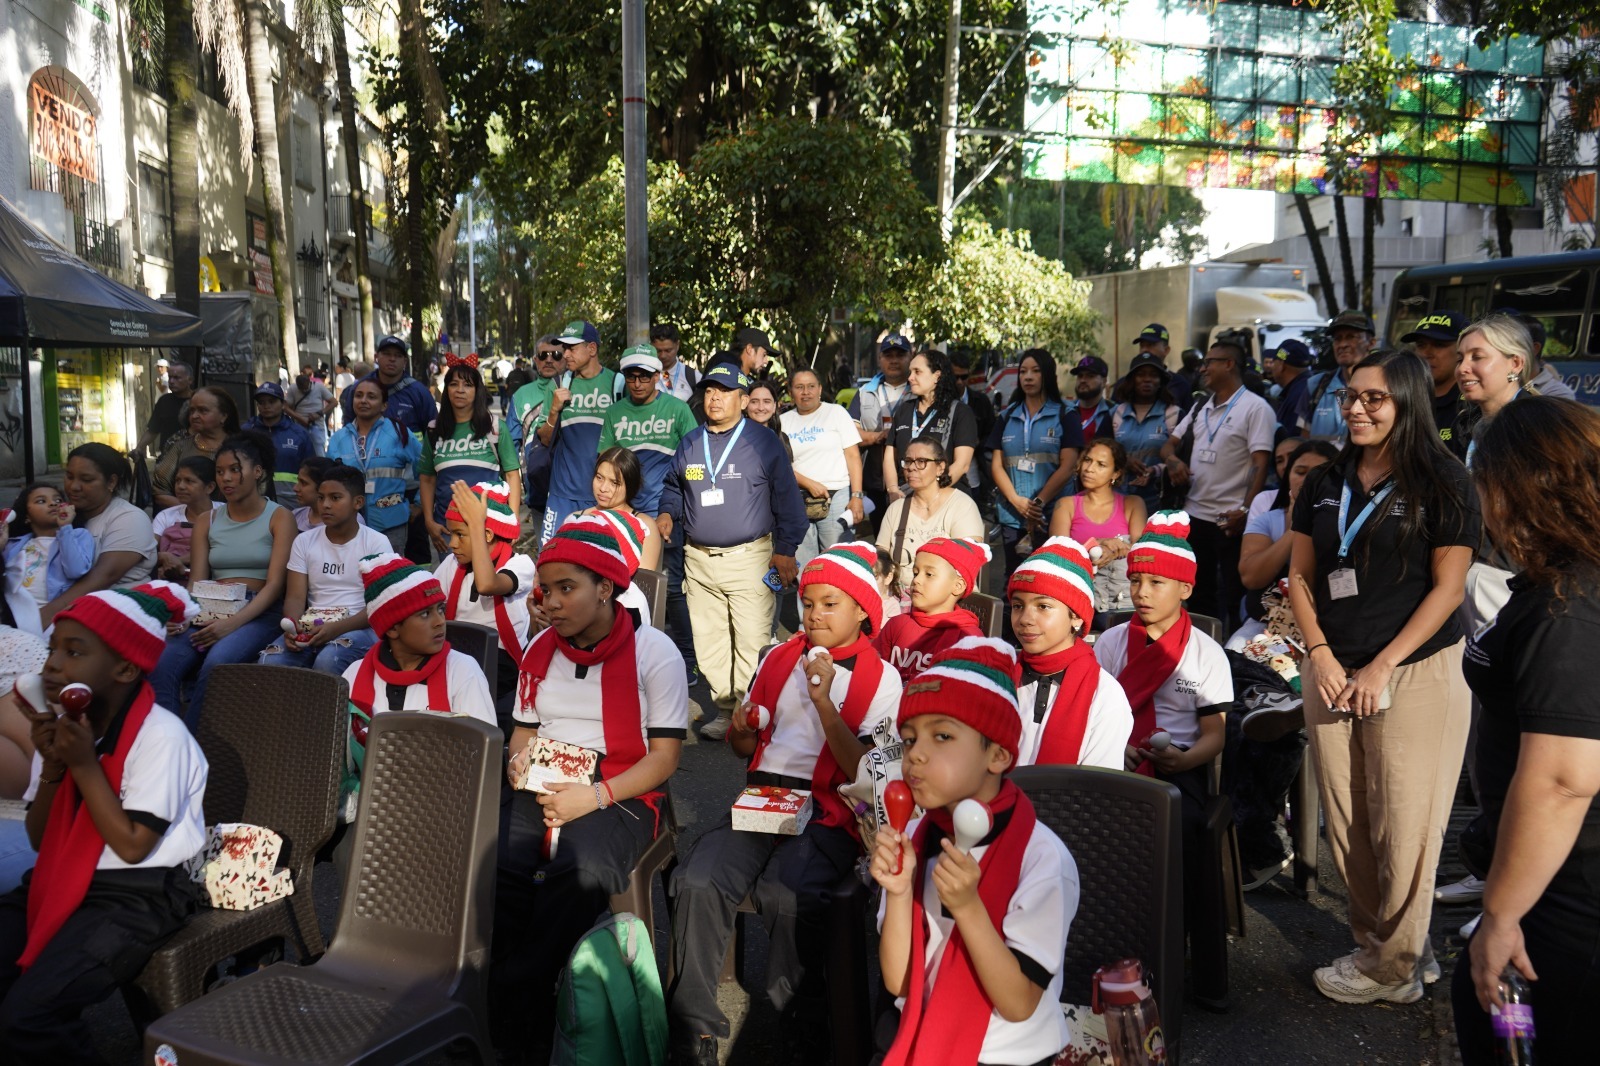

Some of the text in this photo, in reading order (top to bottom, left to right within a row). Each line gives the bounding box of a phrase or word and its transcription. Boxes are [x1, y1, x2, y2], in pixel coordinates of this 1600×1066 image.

[35, 87, 94, 138] VENDO
[570, 387, 613, 409] nde
[613, 414, 676, 441] inder
[322, 562, 345, 575] BOY!
[890, 645, 934, 672] NAS
